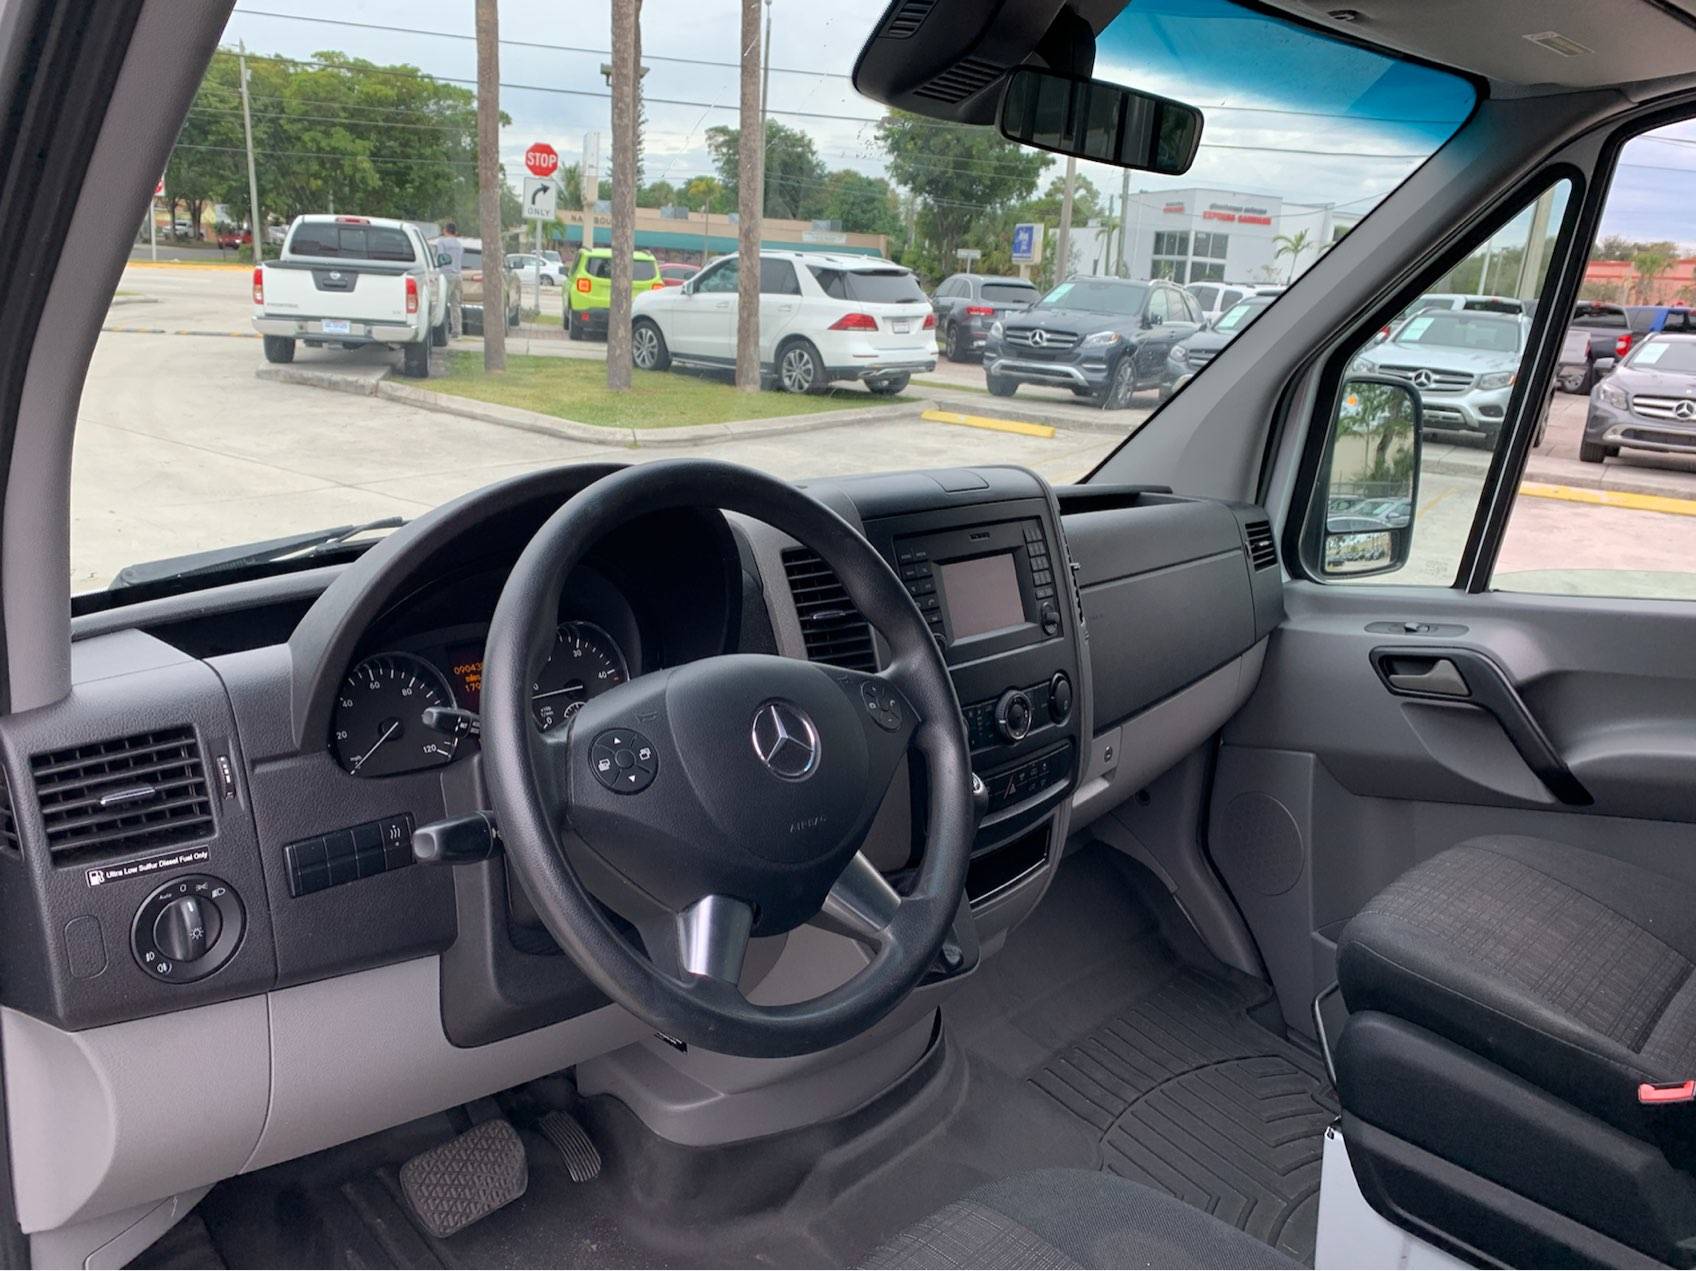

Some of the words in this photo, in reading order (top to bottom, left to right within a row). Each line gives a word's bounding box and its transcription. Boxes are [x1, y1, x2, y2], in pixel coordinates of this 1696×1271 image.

[527, 152, 557, 167] STOP
[528, 208, 550, 217] ONLY
[572, 649, 582, 658] 30
[598, 671, 607, 679] 40
[369, 681, 380, 689] 60
[401, 687, 412, 696] 80
[342, 699, 353, 707] 40
[336, 730, 348, 740] 20
[423, 744, 437, 753] 120
[106, 870, 123, 879] Ultra
[123, 866, 138, 874] Low
[138, 862, 158, 872] Sulfur
[159, 857, 178, 868] Diesel
[179, 854, 193, 863] Fuel
[193, 851, 208, 860] Only
